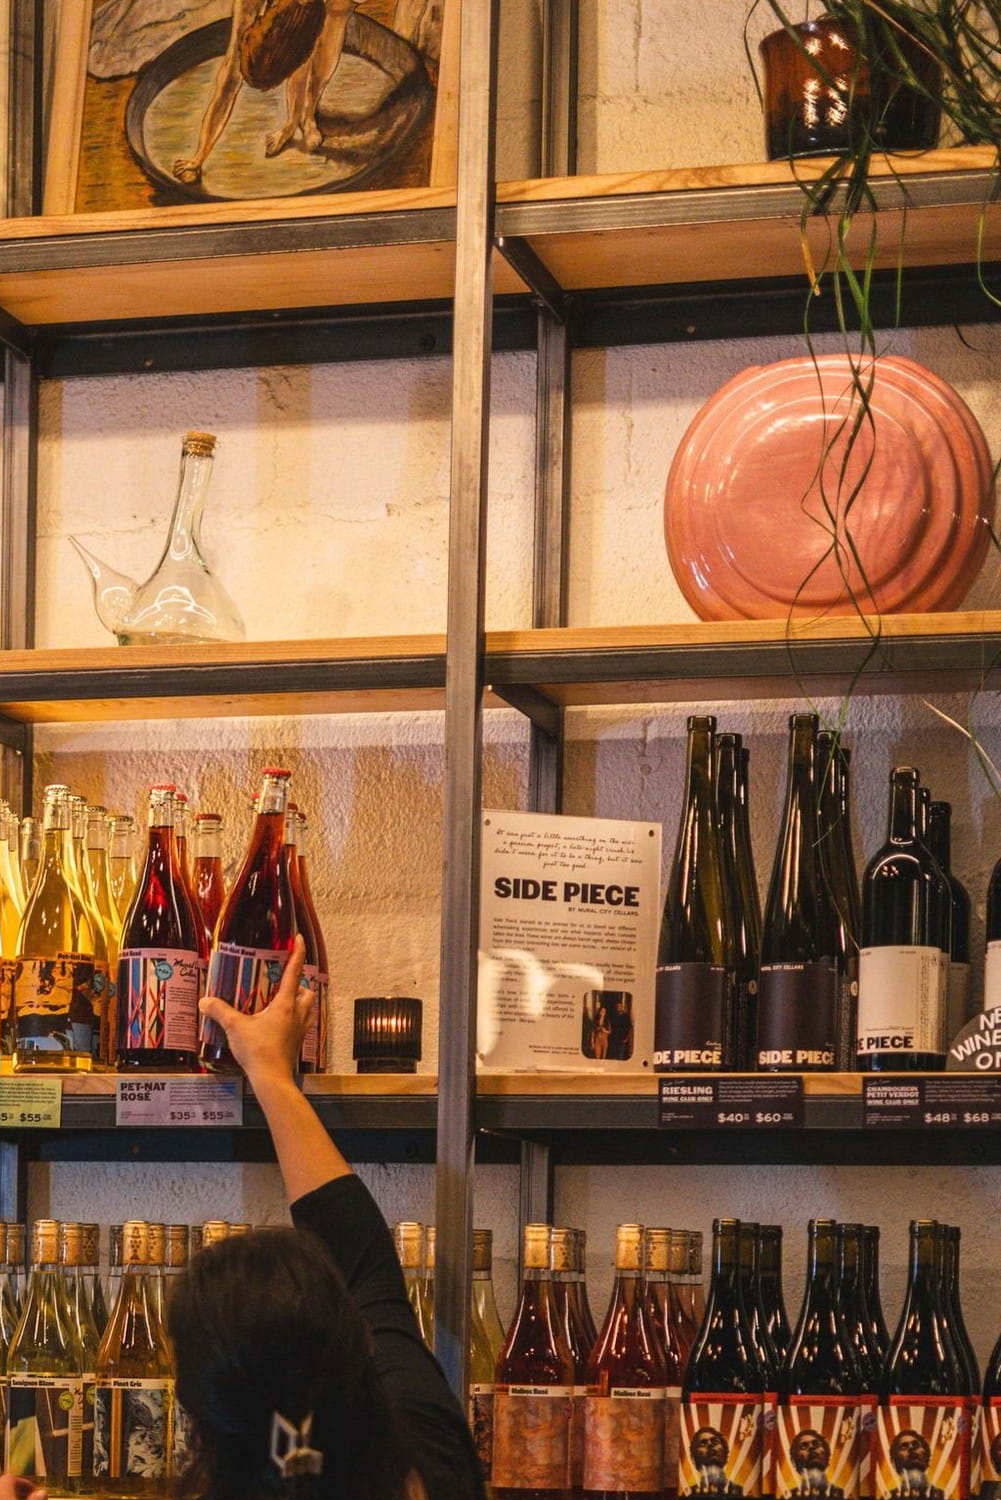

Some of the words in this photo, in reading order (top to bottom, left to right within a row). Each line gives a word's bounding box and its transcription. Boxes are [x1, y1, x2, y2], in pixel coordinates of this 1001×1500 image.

[494, 877, 558, 901] SIDE
[563, 882, 640, 907] PIECE
[867, 1036, 914, 1050] PIECE
[653, 1051, 671, 1065] DE
[674, 1050, 721, 1064] PIECE
[759, 1051, 788, 1065] SIDE
[120, 1082, 167, 1091] PET-NAT
[662, 1086, 713, 1095] RIESLING
[120, 1090, 151, 1101] ROSÉ
[19, 1112, 41, 1122] $55
[170, 1111, 190, 1120] $35
[202, 1111, 224, 1120] $55
[717, 1112, 743, 1123] $40
[755, 1112, 781, 1123] $60
[924, 1112, 950, 1123] $48
[963, 1112, 990, 1123] $68
